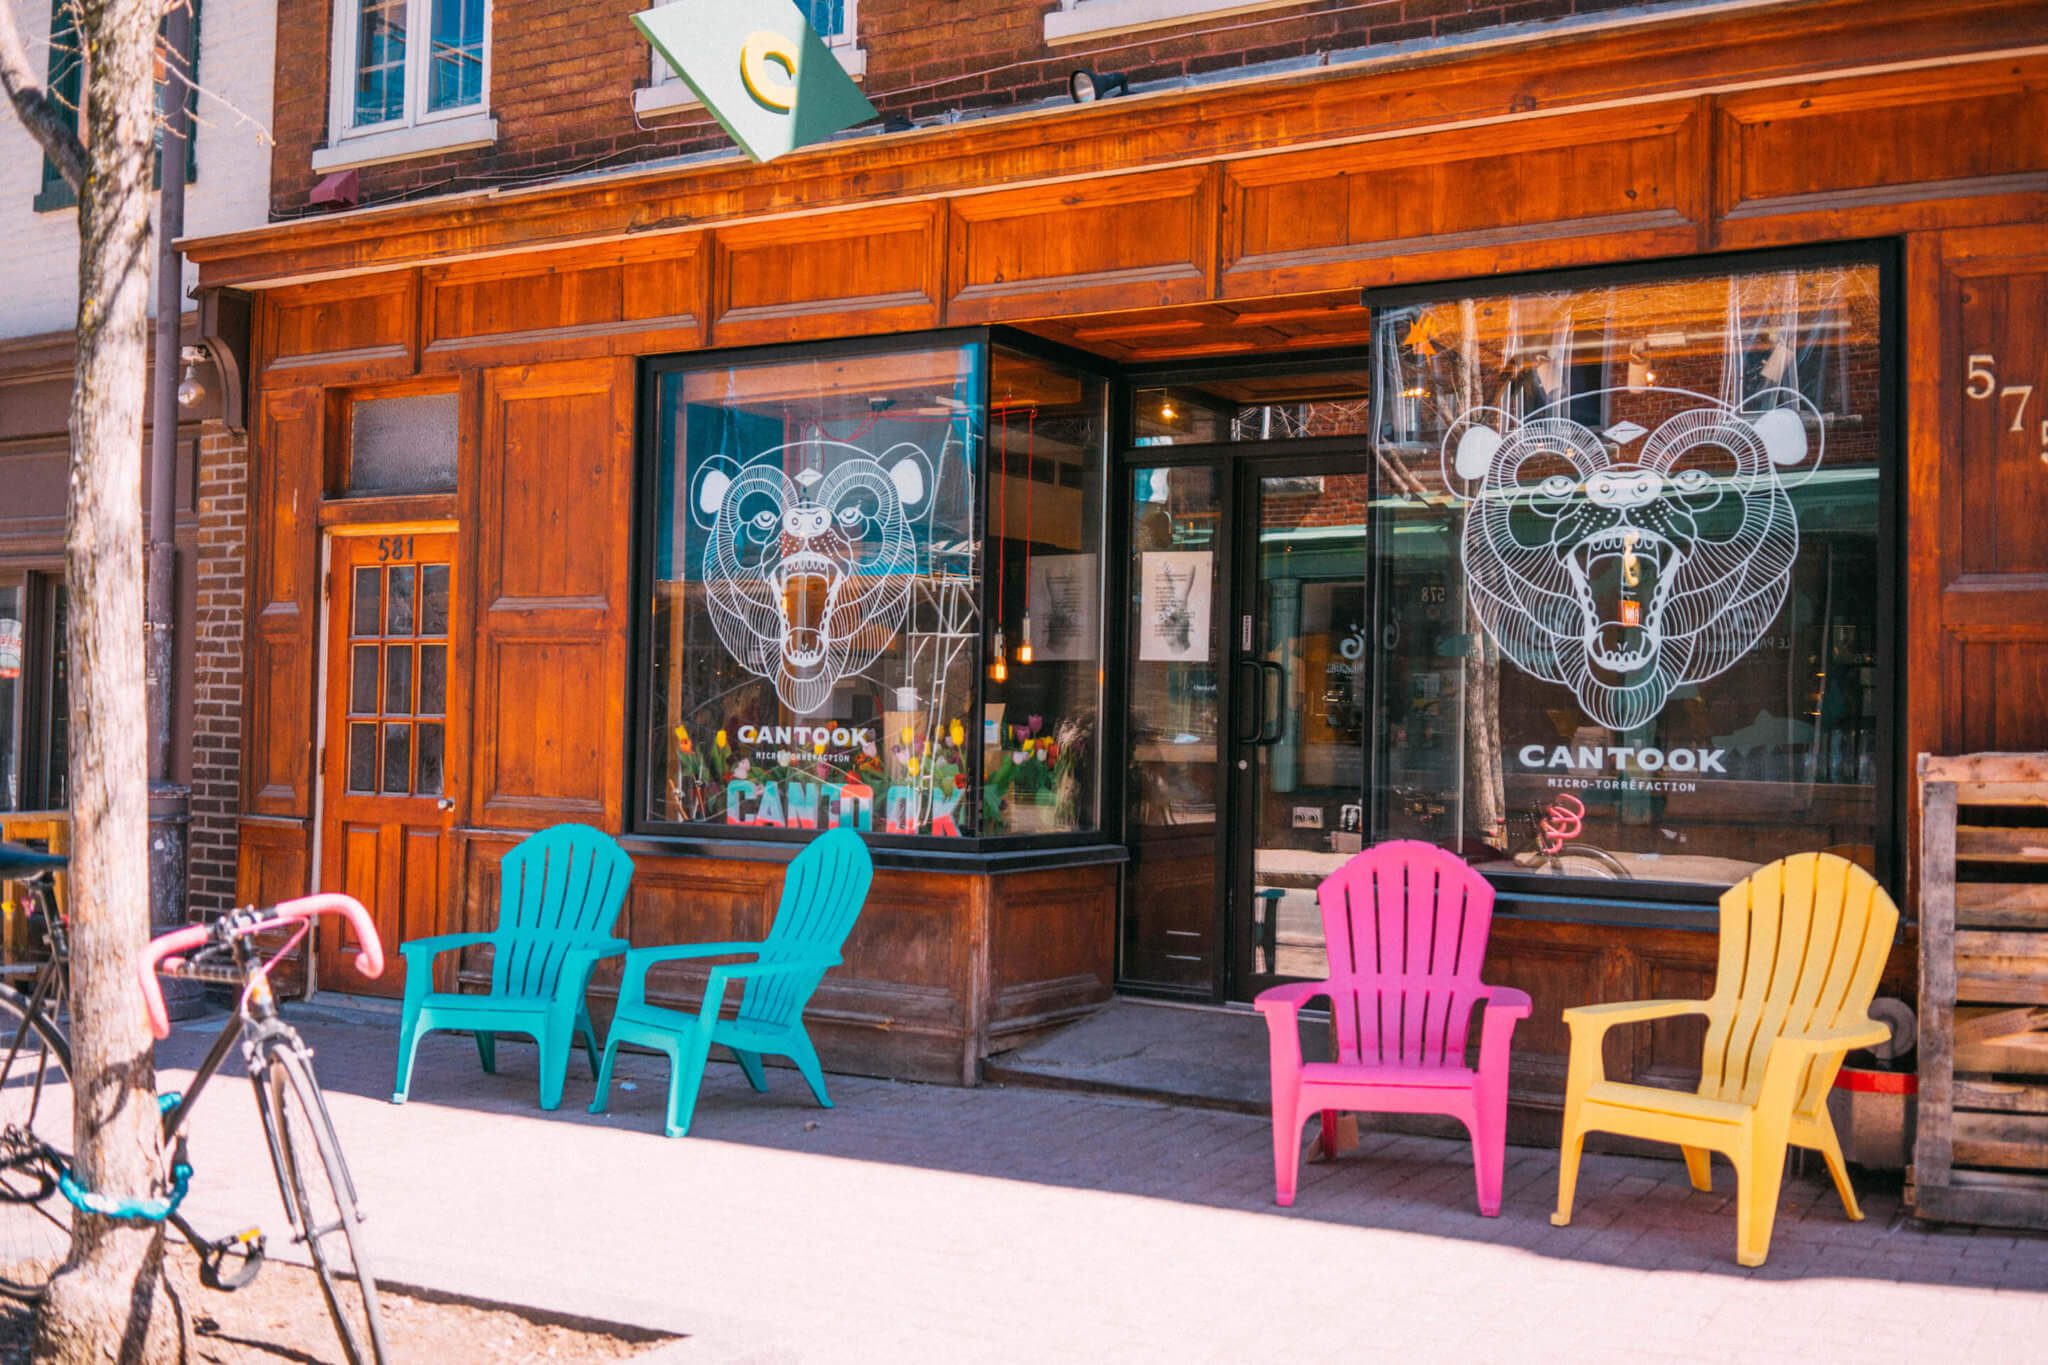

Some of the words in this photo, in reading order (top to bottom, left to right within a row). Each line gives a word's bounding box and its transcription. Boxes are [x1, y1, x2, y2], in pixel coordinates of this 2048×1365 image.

[1966, 354, 2048, 465] 57
[378, 535, 414, 561] 581
[737, 725, 868, 746] CANTOOK
[1519, 744, 1728, 773] CANTOOK
[1548, 777, 1697, 793] MICRO-TORRÉFACTION
